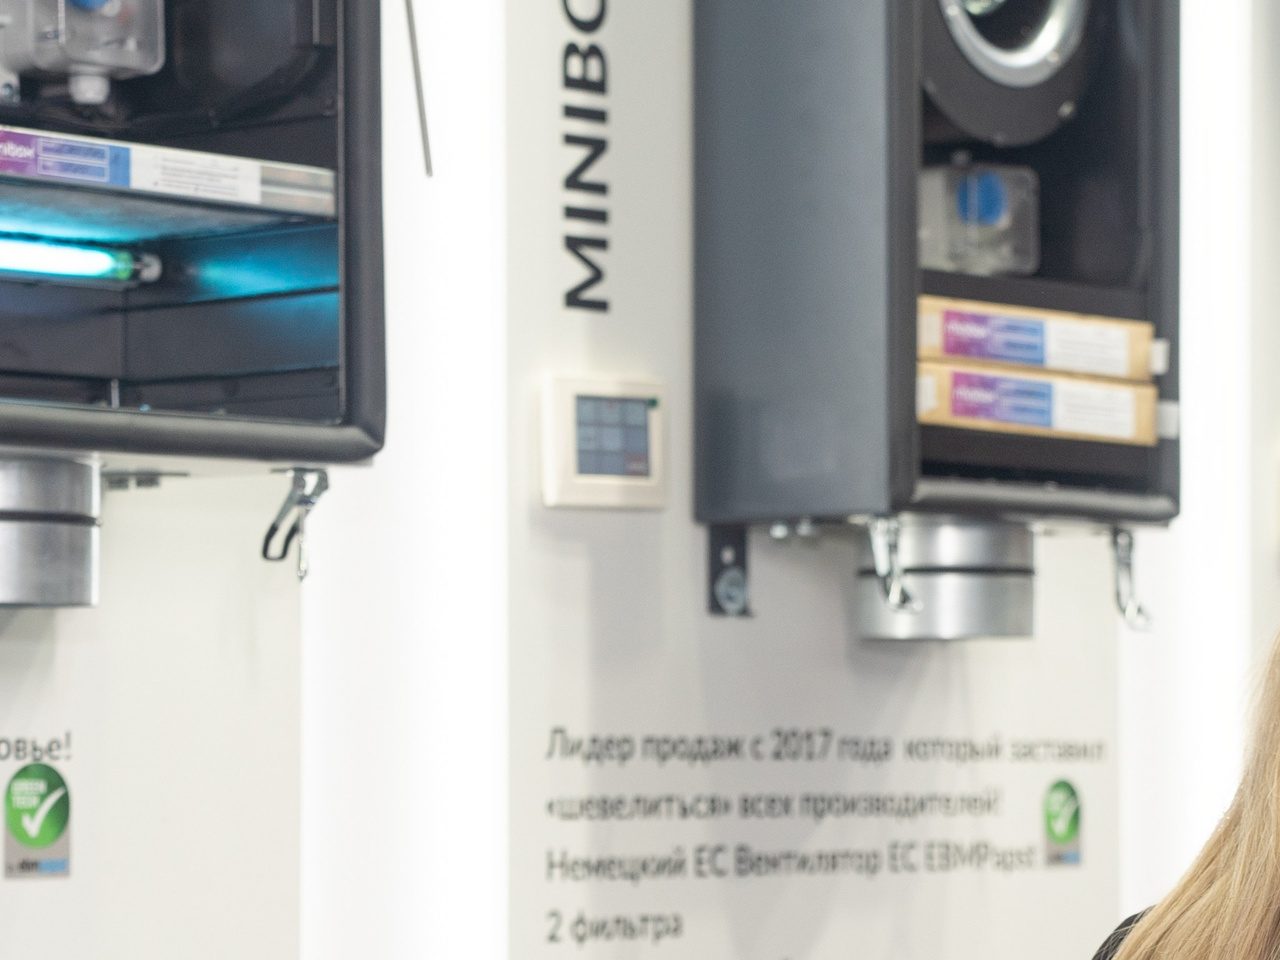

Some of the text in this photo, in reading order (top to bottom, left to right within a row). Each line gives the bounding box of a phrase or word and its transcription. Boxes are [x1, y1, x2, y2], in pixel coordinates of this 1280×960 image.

[546, 727, 635, 766] Лидер
[641, 735, 743, 767] продаж
[771, 727, 834, 762] 2017
[838, 735, 892, 767] года
[904, 733, 1002, 767] который
[737, 794, 792, 819] всех
[546, 846, 687, 885] Немецкий
[734, 844, 881, 882] Вентилятор
[547, 911, 684, 947] 2 фильтра
